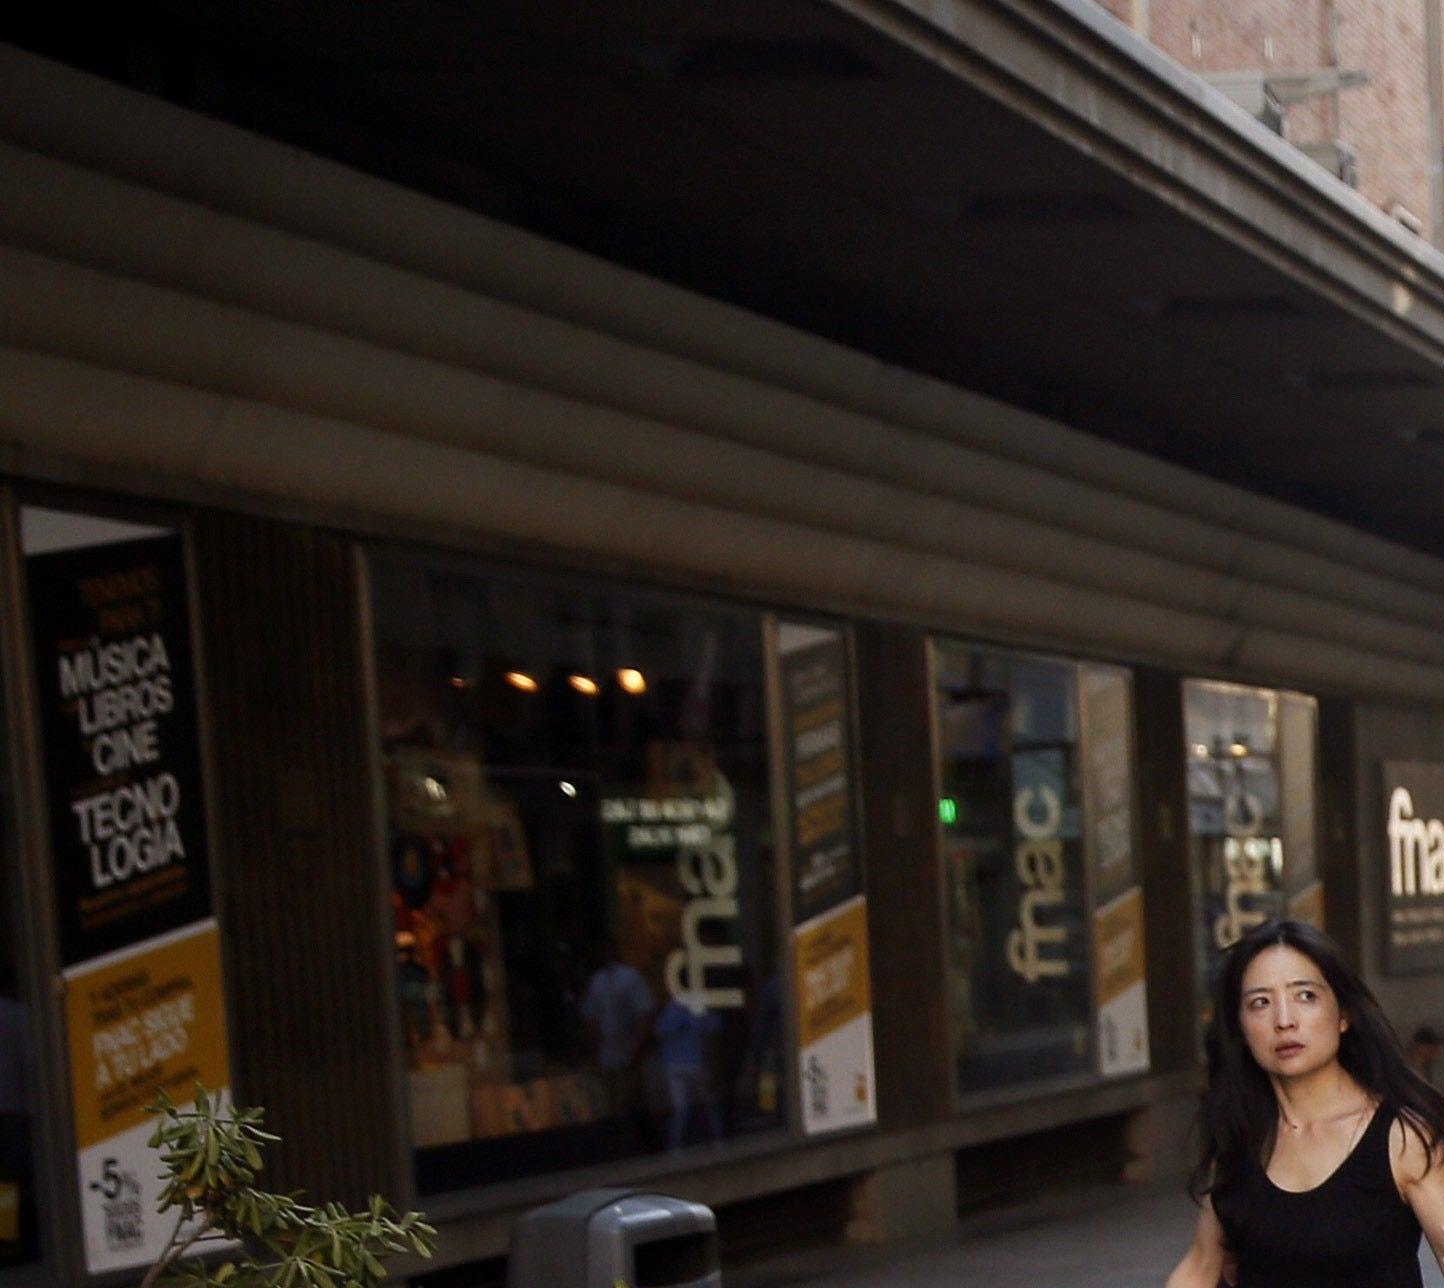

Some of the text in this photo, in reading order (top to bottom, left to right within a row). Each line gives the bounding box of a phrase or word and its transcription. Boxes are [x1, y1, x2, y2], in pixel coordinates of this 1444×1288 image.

[79, 674, 175, 736] LIBROS
[92, 720, 161, 776] CINE
[70, 771, 181, 846] TECNO
[1005, 786, 1071, 984] fnac
